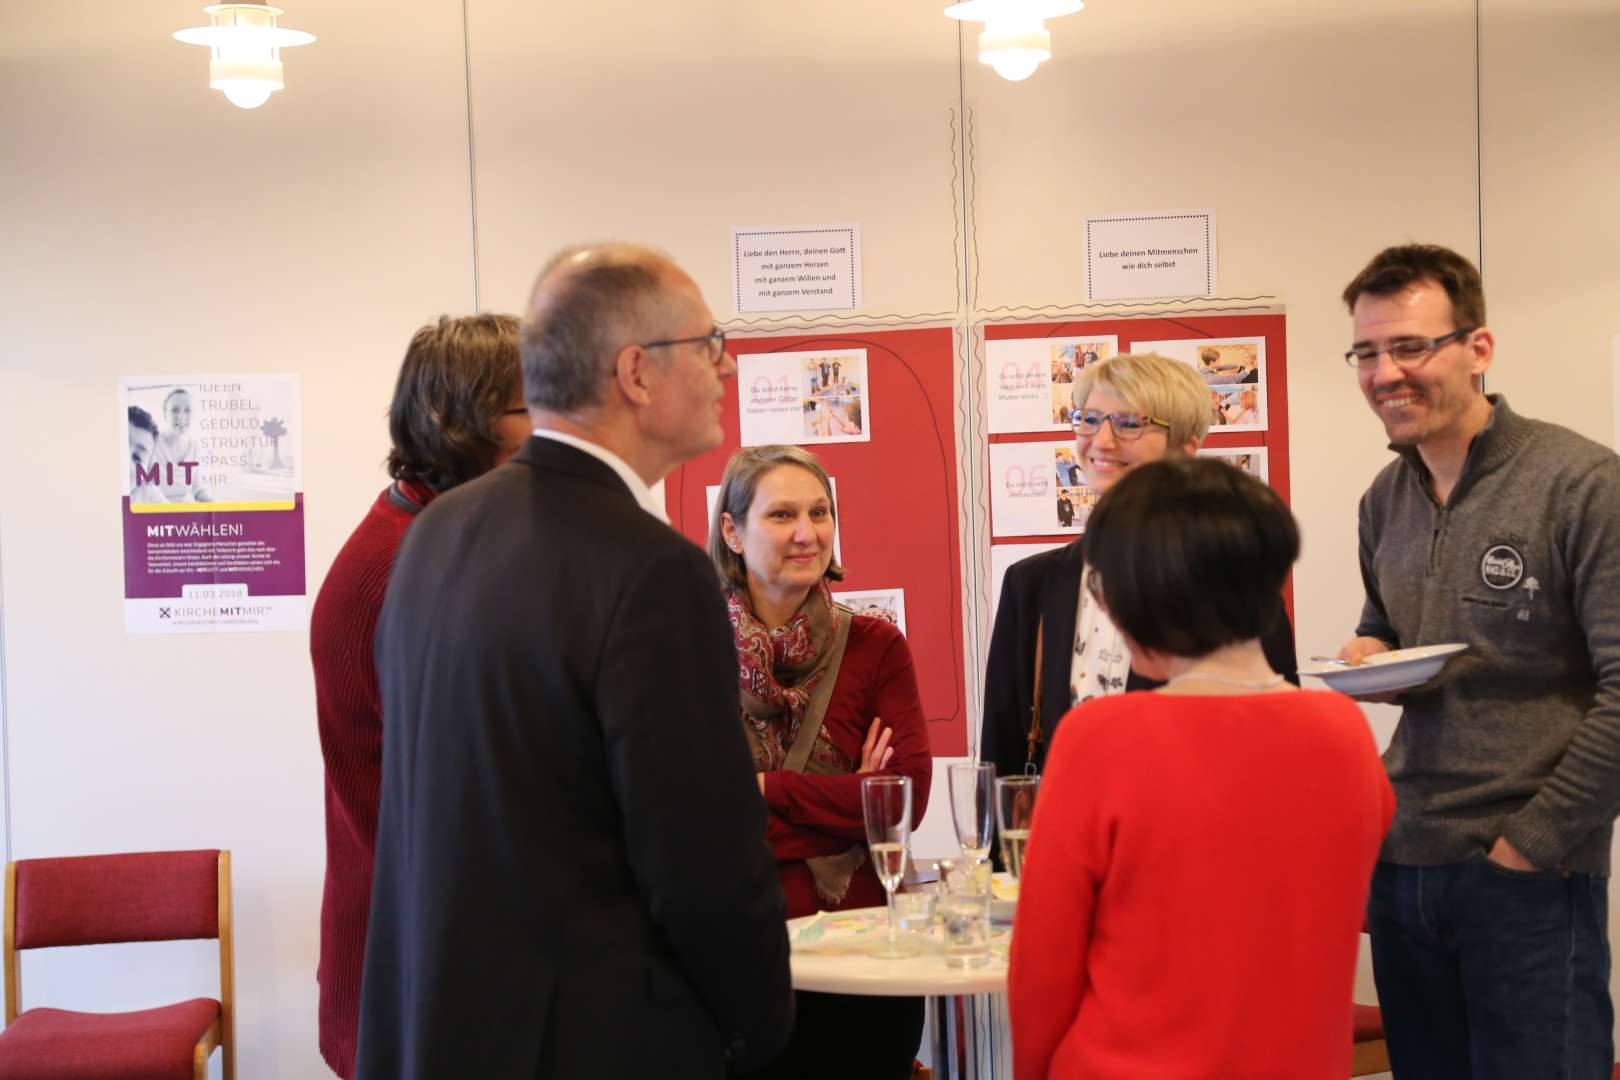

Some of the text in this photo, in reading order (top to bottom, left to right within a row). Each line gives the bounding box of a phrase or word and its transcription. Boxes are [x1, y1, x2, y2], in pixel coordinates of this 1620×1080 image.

[743, 250, 763, 258] Liebe
[764, 249, 778, 257] den
[779, 249, 802, 257] Herrn,
[803, 247, 828, 255] deinen
[1120, 249, 1146, 257] deinen
[1147, 247, 1198, 256] Mitmenschen
[775, 263, 802, 271] ganzem
[803, 261, 829, 269] Herzen
[1121, 261, 1176, 270] wie dich selbst
[754, 276, 767, 284] mit
[768, 276, 796, 285] ganzem
[797, 274, 821, 282] Willen
[772, 290, 800, 298] ganzem
[801, 288, 833, 296] Verstand
[135, 461, 199, 487] MIT
